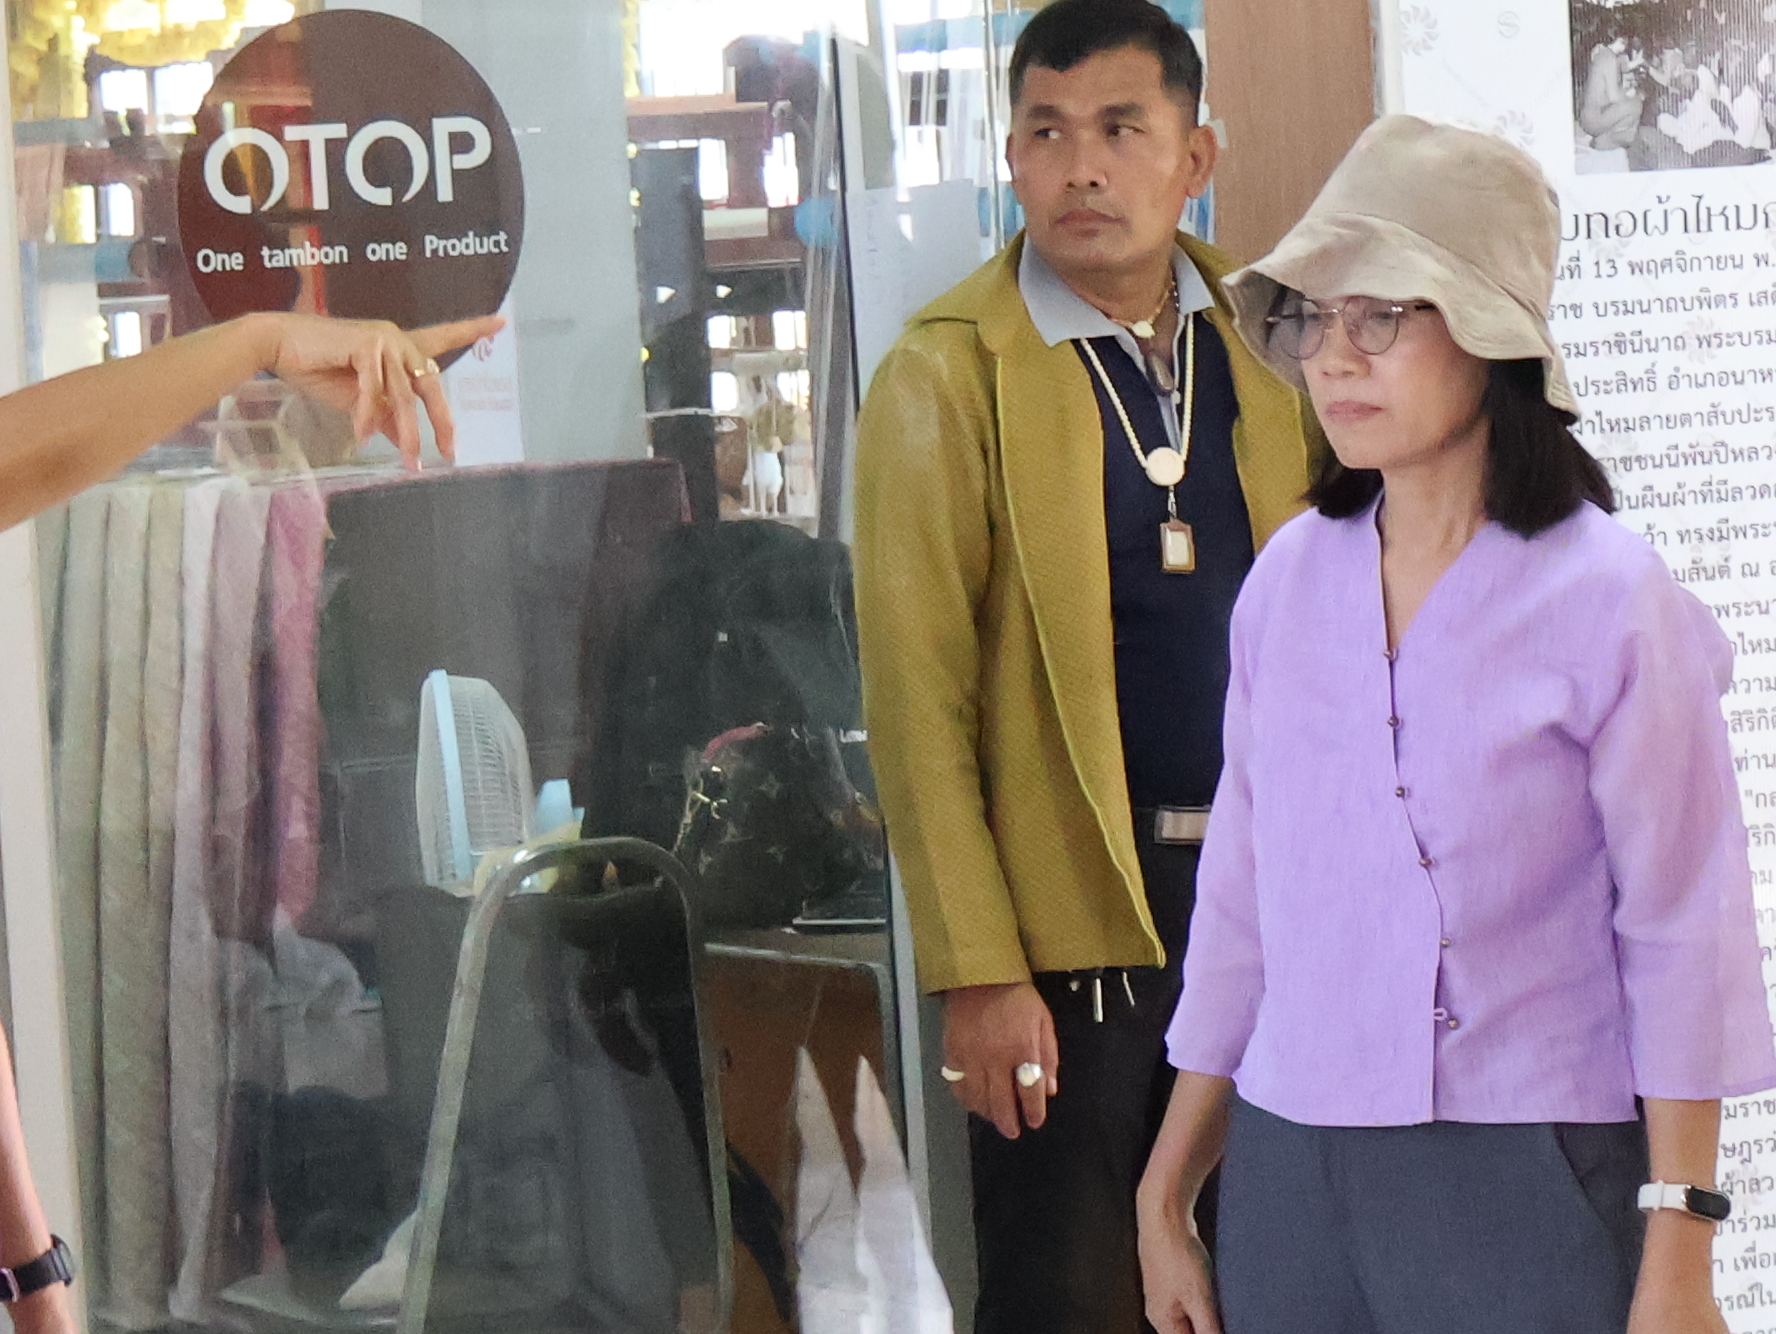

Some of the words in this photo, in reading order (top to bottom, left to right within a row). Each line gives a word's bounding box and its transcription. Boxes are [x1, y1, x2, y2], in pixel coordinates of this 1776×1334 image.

[203, 115, 492, 214] OTOP
[196, 248, 244, 274] One
[260, 241, 349, 269] tambon
[366, 239, 408, 262] one
[424, 230, 510, 259] Product
[1592, 257, 1619, 280] 13
[1627, 248, 1743, 280] พฤศจิกายน
[1592, 286, 1739, 319] บรมนาถบพิตร
[1739, 561, 1761, 579] ณ
